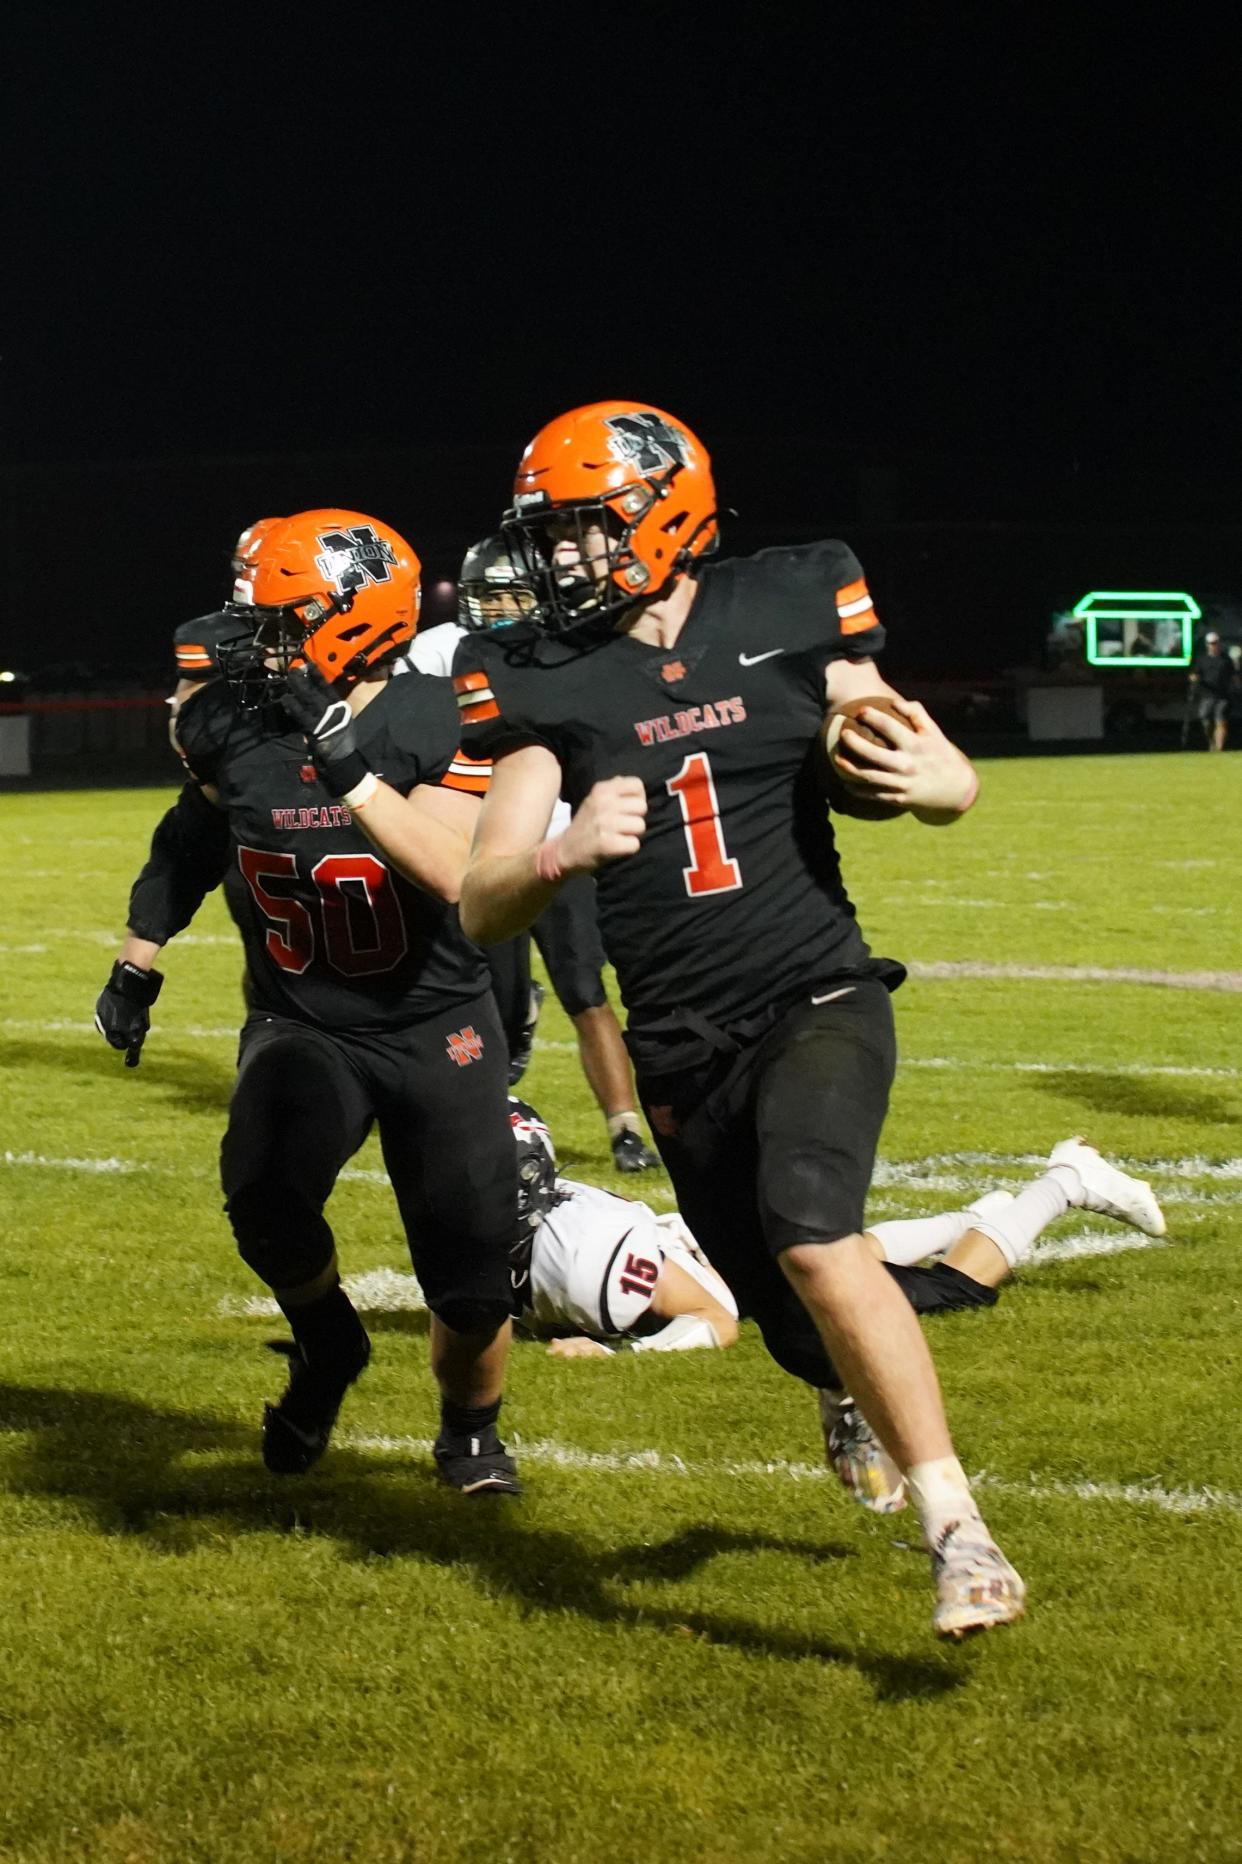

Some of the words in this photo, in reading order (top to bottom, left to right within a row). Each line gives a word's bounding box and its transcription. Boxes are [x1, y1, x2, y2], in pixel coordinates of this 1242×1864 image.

[316, 524, 392, 596] N
[634, 696, 747, 746] WILDCATS
[271, 805, 353, 830] WILDCATS
[665, 751, 743, 897] 1
[238, 845, 408, 977] 50
[617, 1252, 662, 1300] 15
